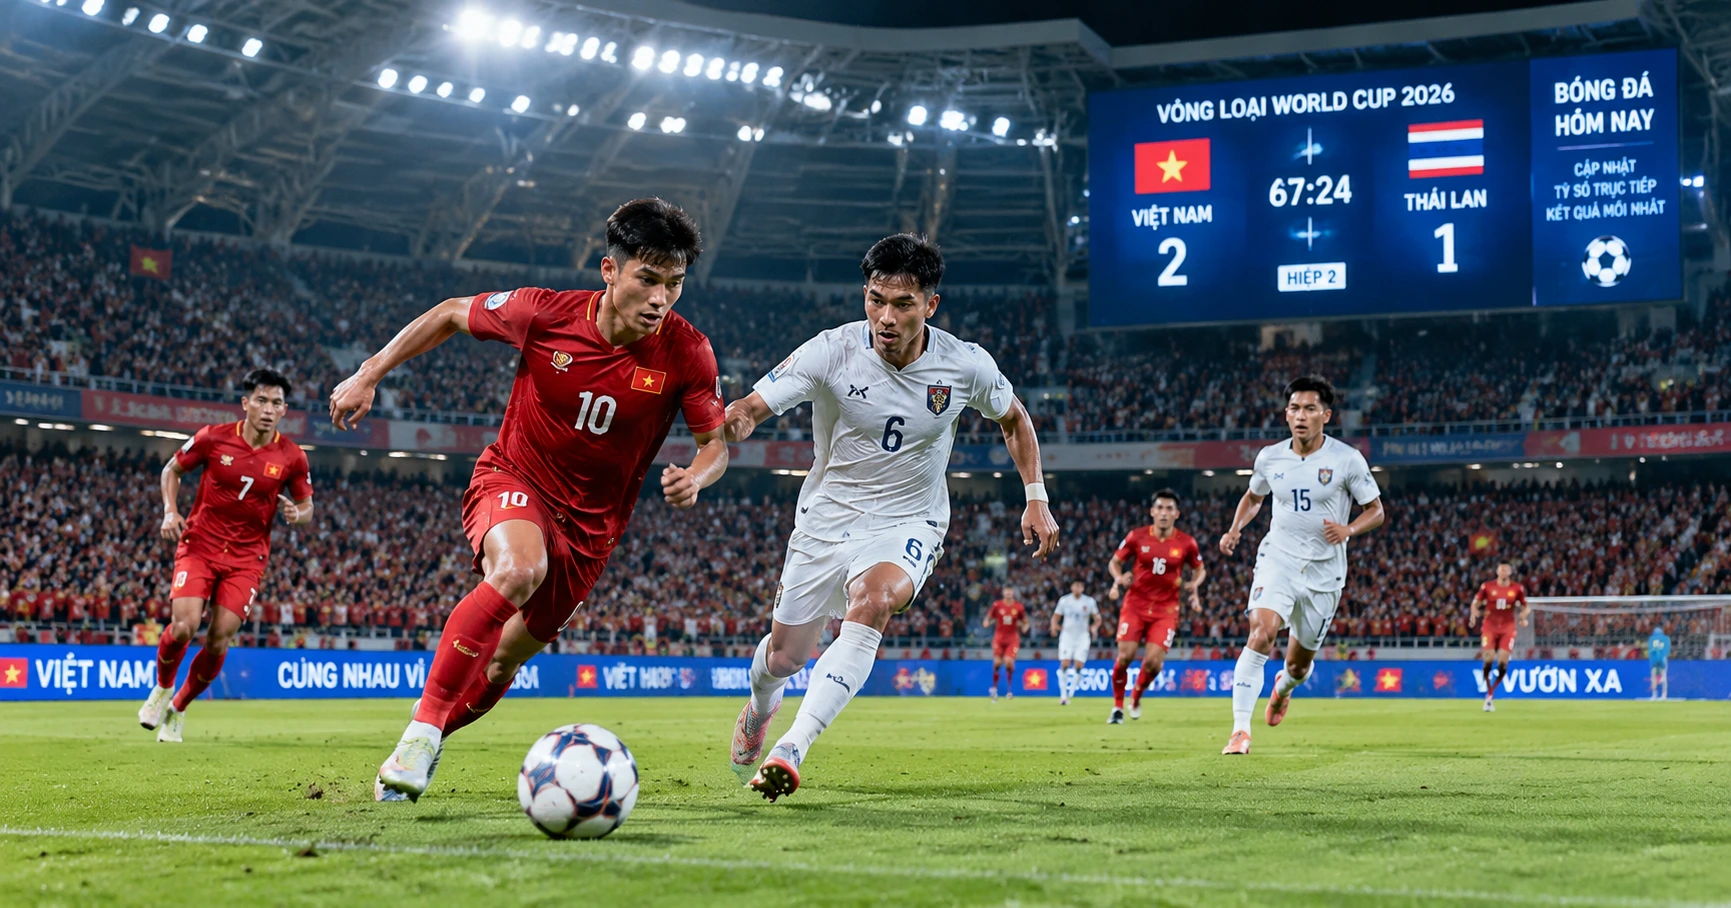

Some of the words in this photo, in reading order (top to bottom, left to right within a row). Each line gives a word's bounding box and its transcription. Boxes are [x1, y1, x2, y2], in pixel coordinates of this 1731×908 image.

[1554, 75, 1616, 104] BÓNG
[1621, 70, 1654, 99] ĐÁ
[1220, 96, 1267, 122] LOẠI
[1271, 91, 1348, 116] WORLD
[1352, 87, 1397, 110] CUP
[1401, 82, 1455, 107] 2026
[1611, 108, 1655, 133] NAY
[1269, 175, 1352, 207] 67:24
[1403, 186, 1446, 212] THÁI
[1450, 188, 1487, 210] LAN
[1131, 204, 1170, 231] VIỆT
[1173, 204, 1213, 225] NAM
[1157, 236, 1188, 287] 2
[1434, 222, 1459, 274] 1
[1287, 267, 1322, 288] HIỆP
[1328, 269, 1336, 284] 2
[574, 391, 617, 436] 10
[881, 416, 905, 453] 6
[238, 475, 254, 501] 7
[497, 491, 528, 509] 10
[1291, 488, 1311, 512] 15
[905, 537, 923, 561] 6
[1152, 557, 1167, 575] 16
[35, 651, 94, 695] VIỆT
[98, 659, 157, 689] NAM
[342, 661, 400, 689] NHAU
[1584, 668, 1623, 693] XA
